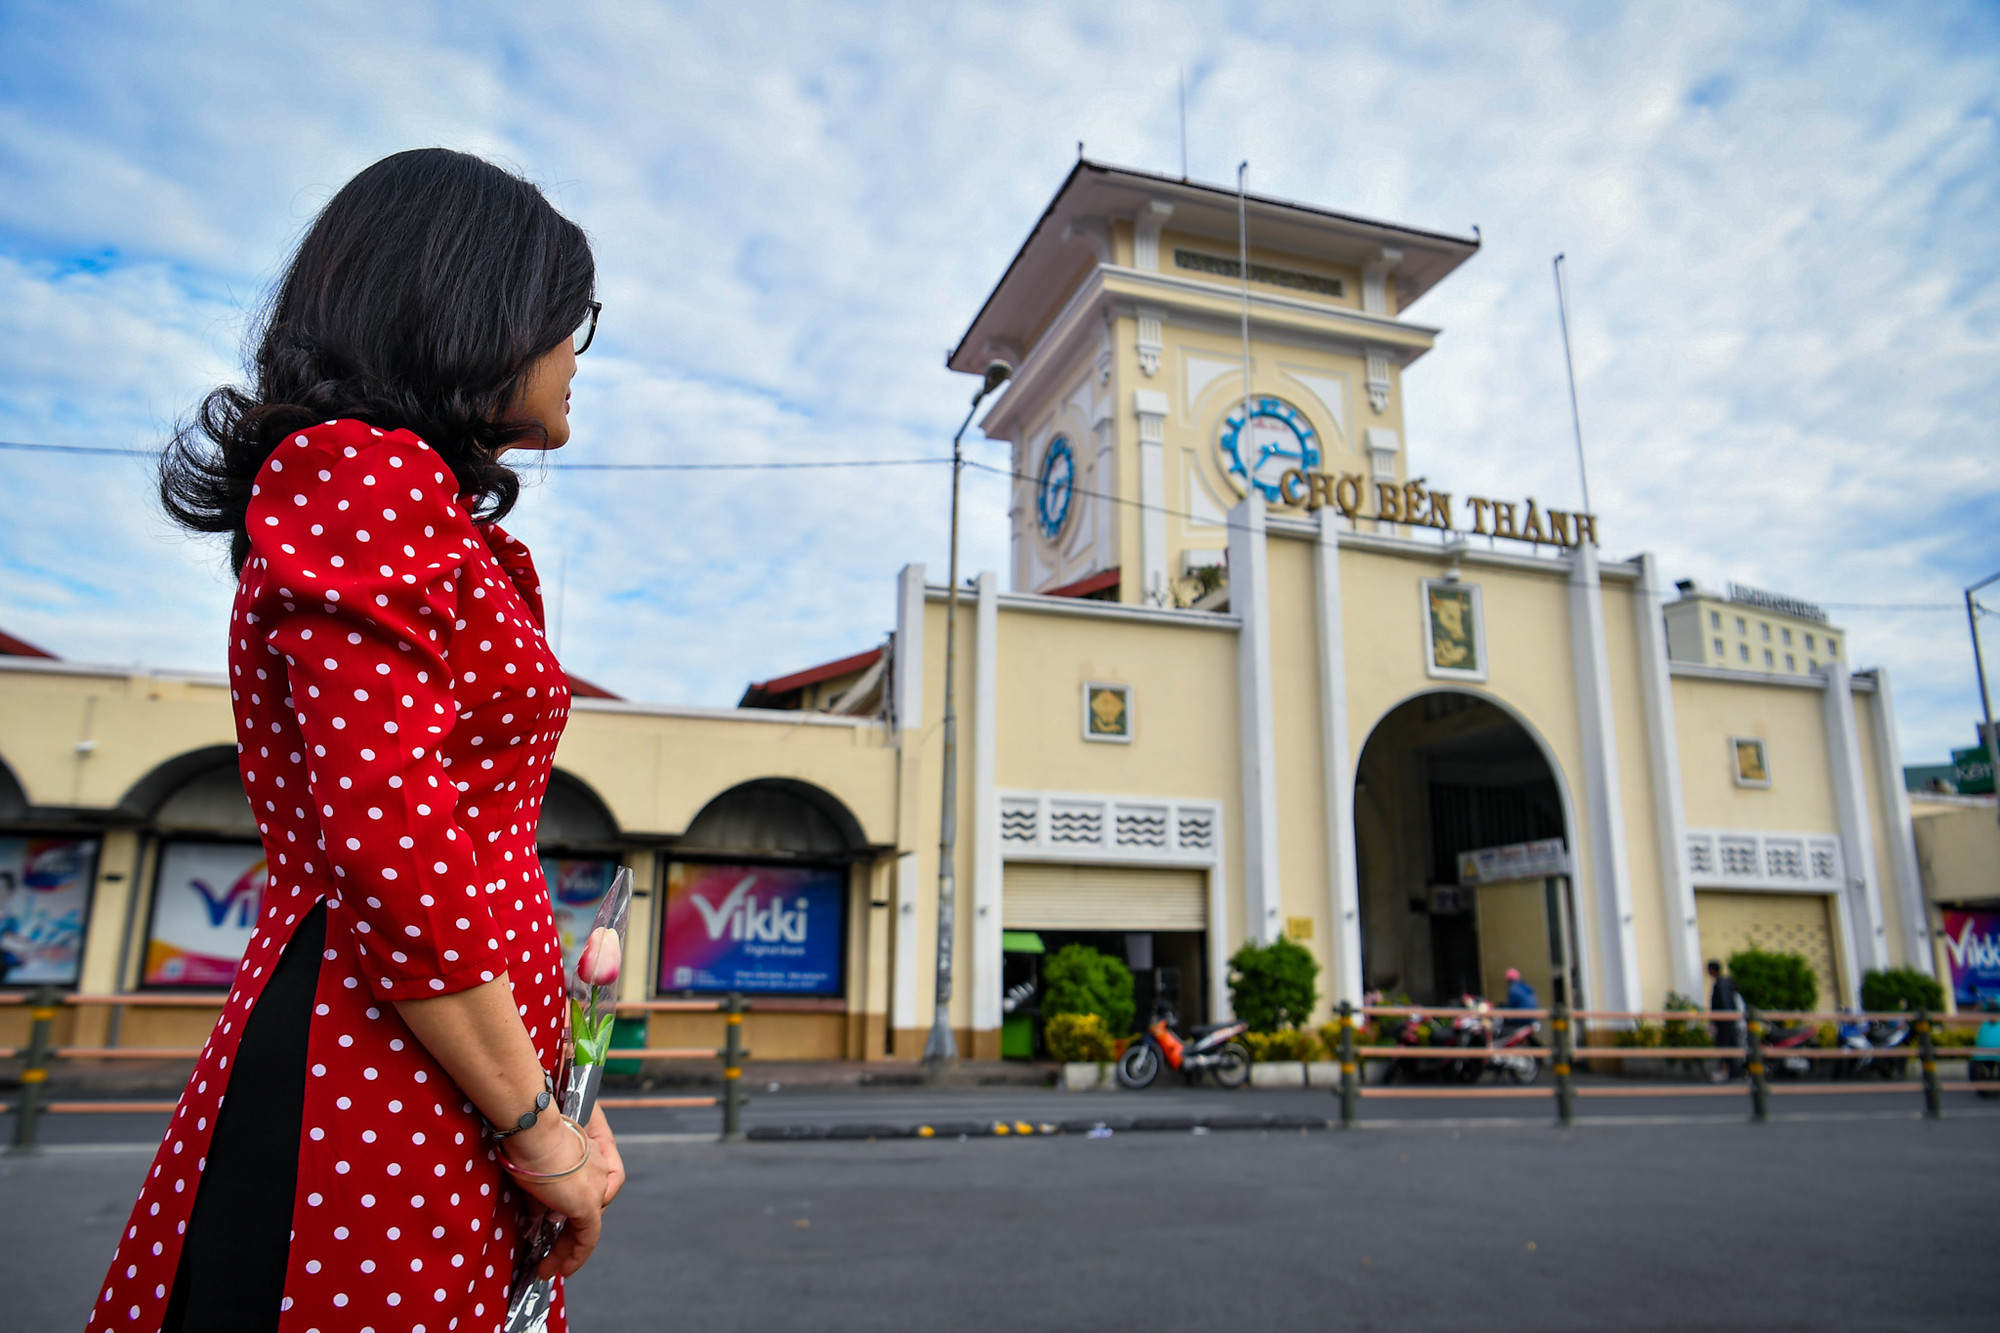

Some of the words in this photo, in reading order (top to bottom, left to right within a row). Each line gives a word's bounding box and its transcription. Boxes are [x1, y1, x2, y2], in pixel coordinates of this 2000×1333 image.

[1376, 477, 1452, 529] BẾN
[1466, 496, 1599, 548] THÀNH
[689, 873, 809, 943] Vikki
